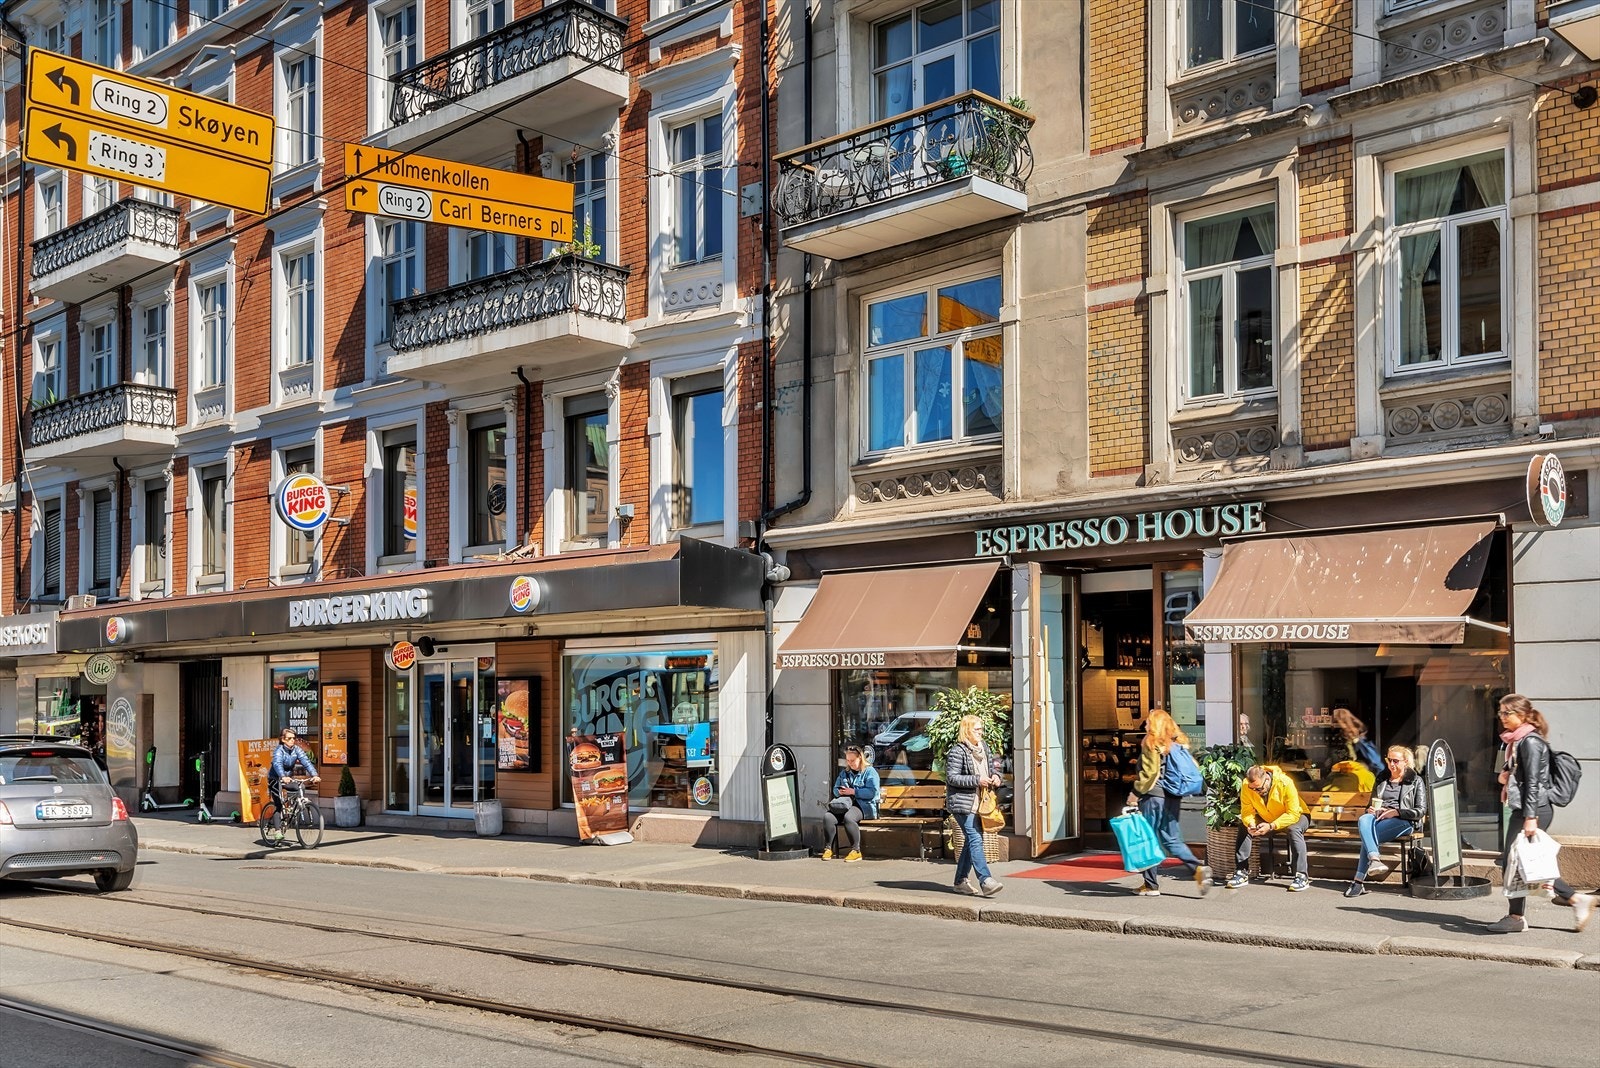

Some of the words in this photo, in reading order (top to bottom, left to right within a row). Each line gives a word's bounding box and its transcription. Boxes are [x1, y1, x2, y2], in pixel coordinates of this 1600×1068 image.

[104, 88, 141, 113] Ring
[147, 99, 157, 115] 2
[178, 105, 259, 146] Skøyen
[101, 142, 138, 168] Ring
[144, 153, 154, 169] 3
[377, 154, 489, 191] Holmenkollen
[385, 191, 413, 211] Ring
[416, 197, 426, 213] 2
[439, 199, 472, 221] Carl
[481, 205, 542, 231] Berners
[551, 220, 567, 237] pl.
[286, 486, 324, 502] BURGER
[288, 495, 326, 515] KING
[975, 515, 1130, 557] ESPRESSO
[1136, 502, 1266, 543] HOUSE
[513, 582, 530, 595] BURGER
[513, 588, 530, 603] KING
[290, 595, 368, 627] BURGER
[370, 588, 427, 620] KING
[1192, 625, 1278, 641] ESPRESSO
[1281, 624, 1350, 640] HOUSE
[393, 646, 414, 657] BURGER
[393, 652, 415, 665] KING
[782, 654, 839, 667] ESPRESSO
[841, 653, 885, 666] HOUSE
[94, 662, 110, 675] life
[279, 690, 318, 700] WHOPPER
[571, 671, 656, 728] BURGER
[289, 707, 308, 718] 100%
[697, 788, 711, 798] KING
[45, 806, 57, 815] EK
[62, 806, 90, 815] 58892
